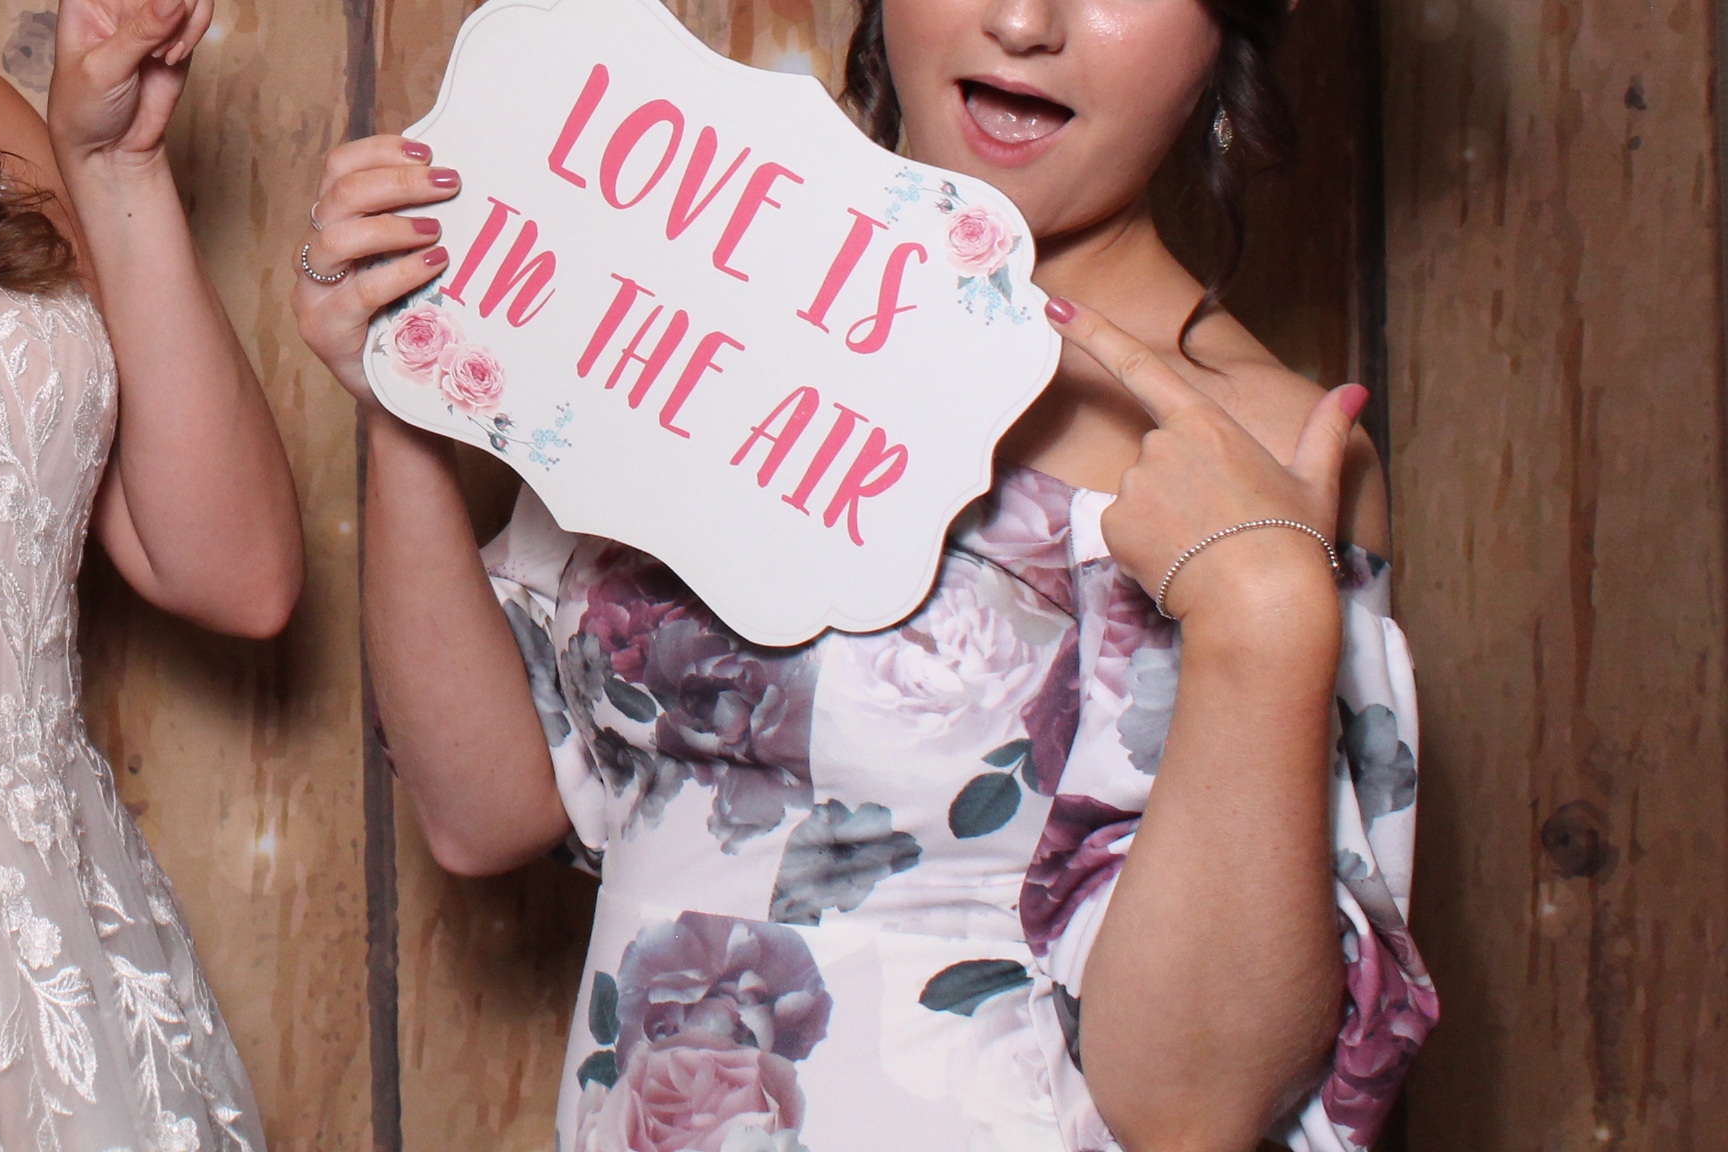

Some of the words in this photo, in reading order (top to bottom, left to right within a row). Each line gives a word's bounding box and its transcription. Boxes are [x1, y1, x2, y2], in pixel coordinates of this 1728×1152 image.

[548, 63, 804, 282] LOVE
[796, 207, 928, 354] IS
[576, 272, 746, 440] THE
[729, 385, 909, 546] AIR
